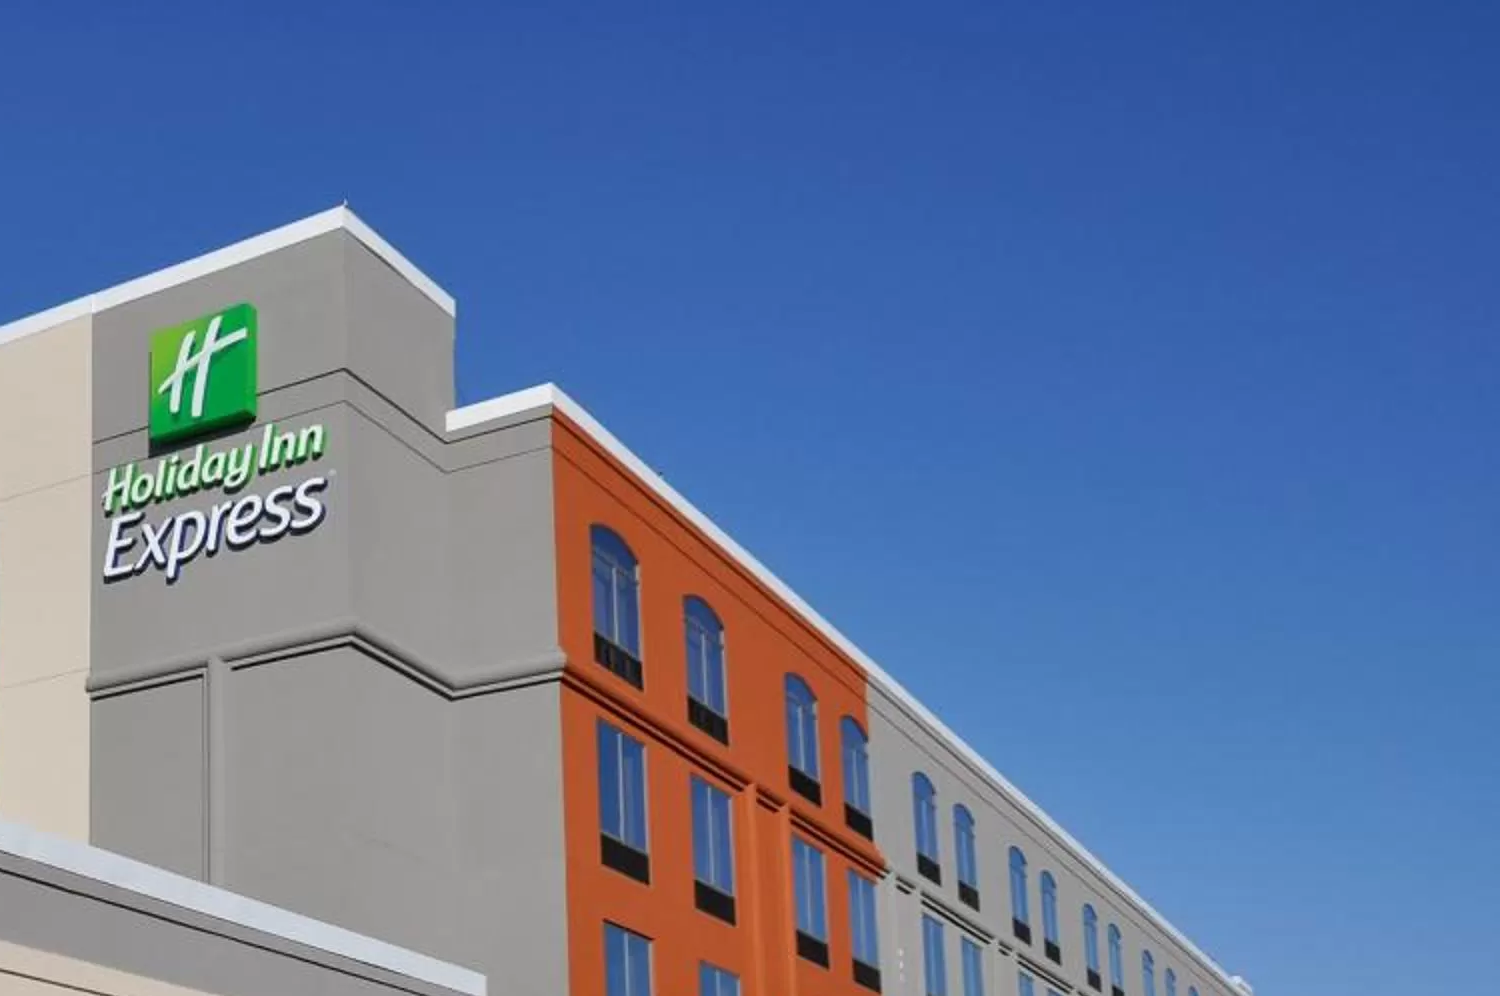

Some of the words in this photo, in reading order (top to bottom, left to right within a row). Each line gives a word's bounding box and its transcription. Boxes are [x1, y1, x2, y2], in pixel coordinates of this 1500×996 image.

[158, 315, 247, 417] H
[102, 444, 255, 514] Holiday
[258, 423, 325, 474] Inn
[103, 476, 328, 582] Express
